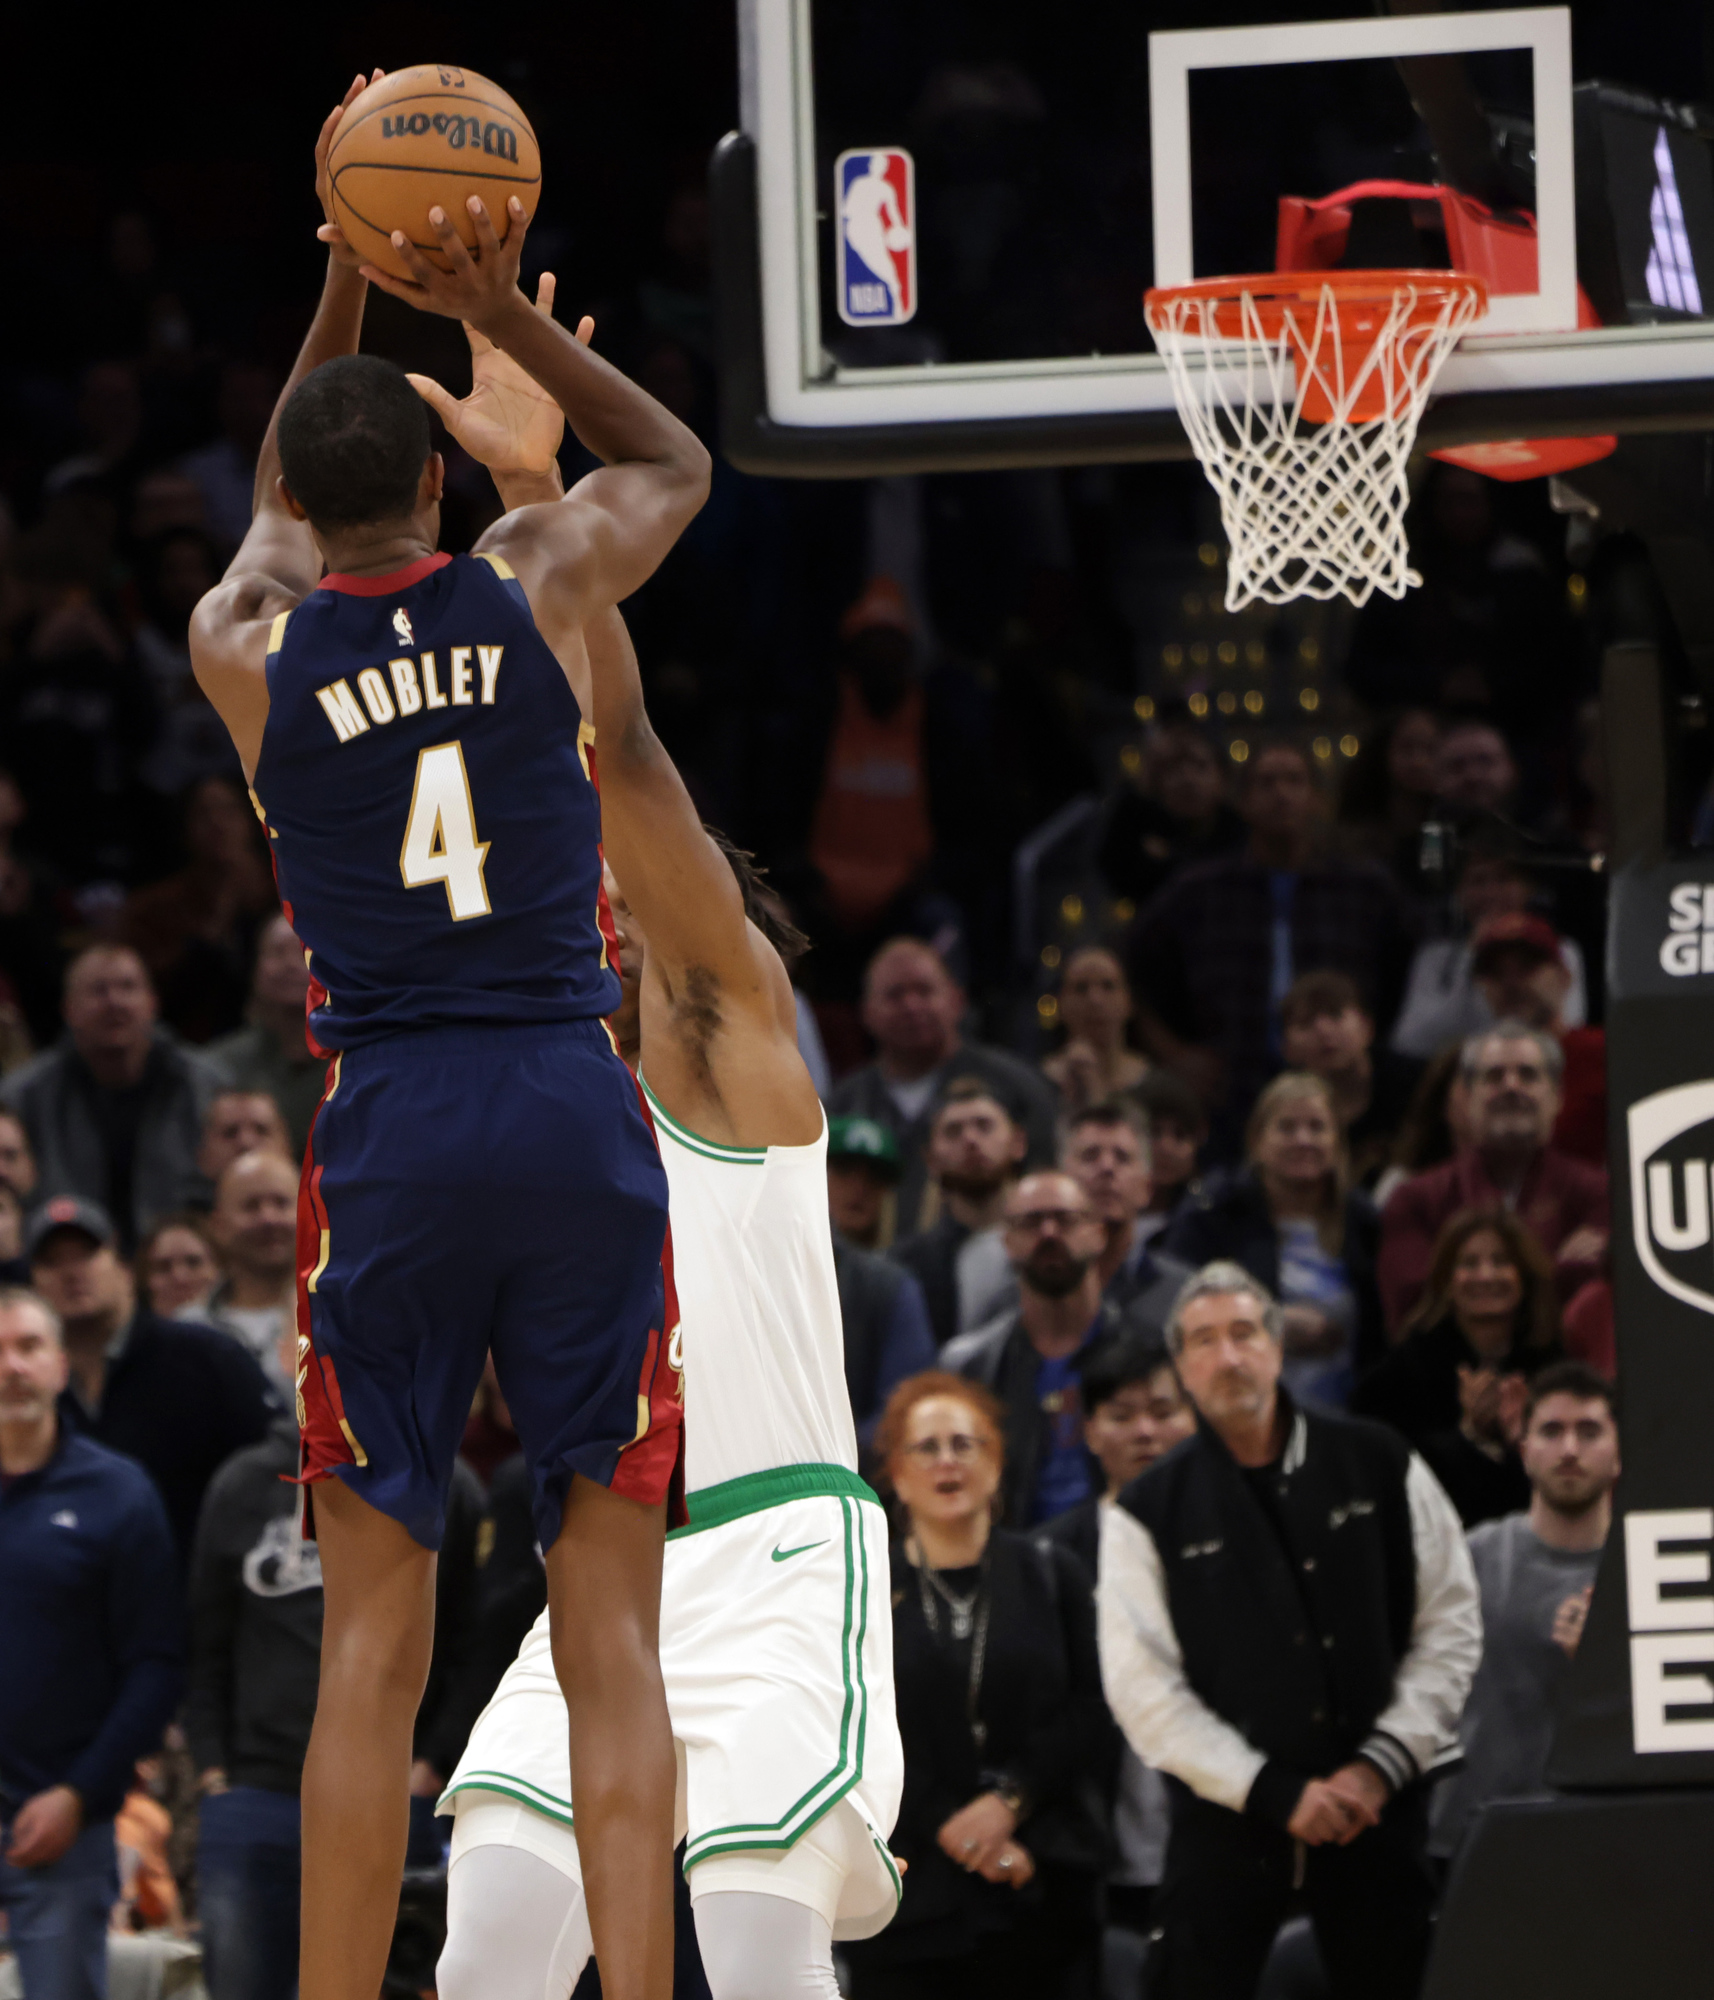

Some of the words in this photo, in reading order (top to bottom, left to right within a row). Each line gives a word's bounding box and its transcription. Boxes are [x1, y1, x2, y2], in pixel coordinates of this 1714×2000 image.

[382, 112, 519, 165] Wilson
[850, 283, 888, 313] NBA
[315, 645, 504, 743] MOBLEY
[399, 740, 492, 922] 4
